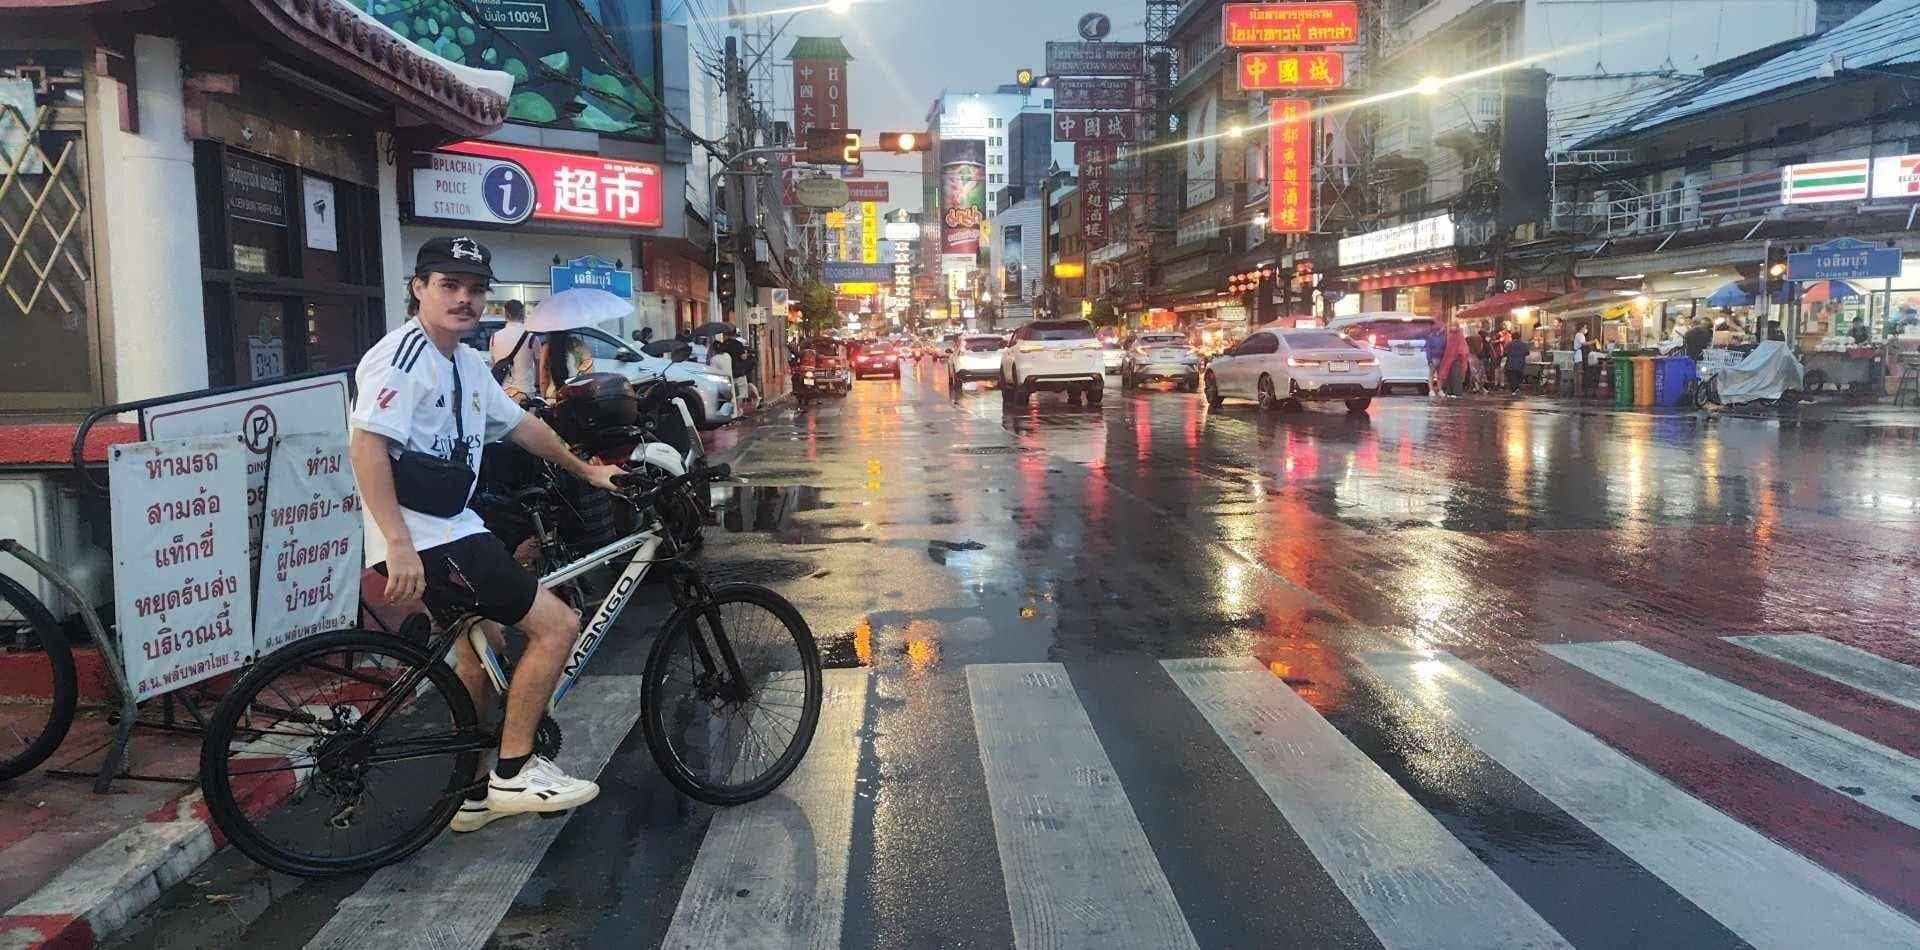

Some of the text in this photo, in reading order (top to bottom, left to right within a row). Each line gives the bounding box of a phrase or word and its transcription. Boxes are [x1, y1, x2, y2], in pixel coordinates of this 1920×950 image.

[508, 11, 541, 23] 100%
[1246, 56, 1333, 85] 中國城
[829, 67, 840, 130] HOTE
[1060, 115, 1126, 139] 中國城
[844, 133, 860, 163] 2
[477, 163, 482, 175] 2
[436, 179, 467, 194] POLICE
[553, 166, 643, 219] 超市
[433, 200, 471, 215] STATION
[145, 448, 218, 480] ห้ามรถ
[306, 447, 342, 476] ห้าม
[147, 486, 221, 525] สามล้อ
[156, 522, 214, 568] แท็กซี่
[276, 537, 349, 582] ผู้โดยสาร
[135, 569, 238, 624] หยุดรับส่ง
[143, 601, 233, 661] บริเวณนี้
[563, 576, 634, 678] MANGO
[233, 651, 241, 662] 2
